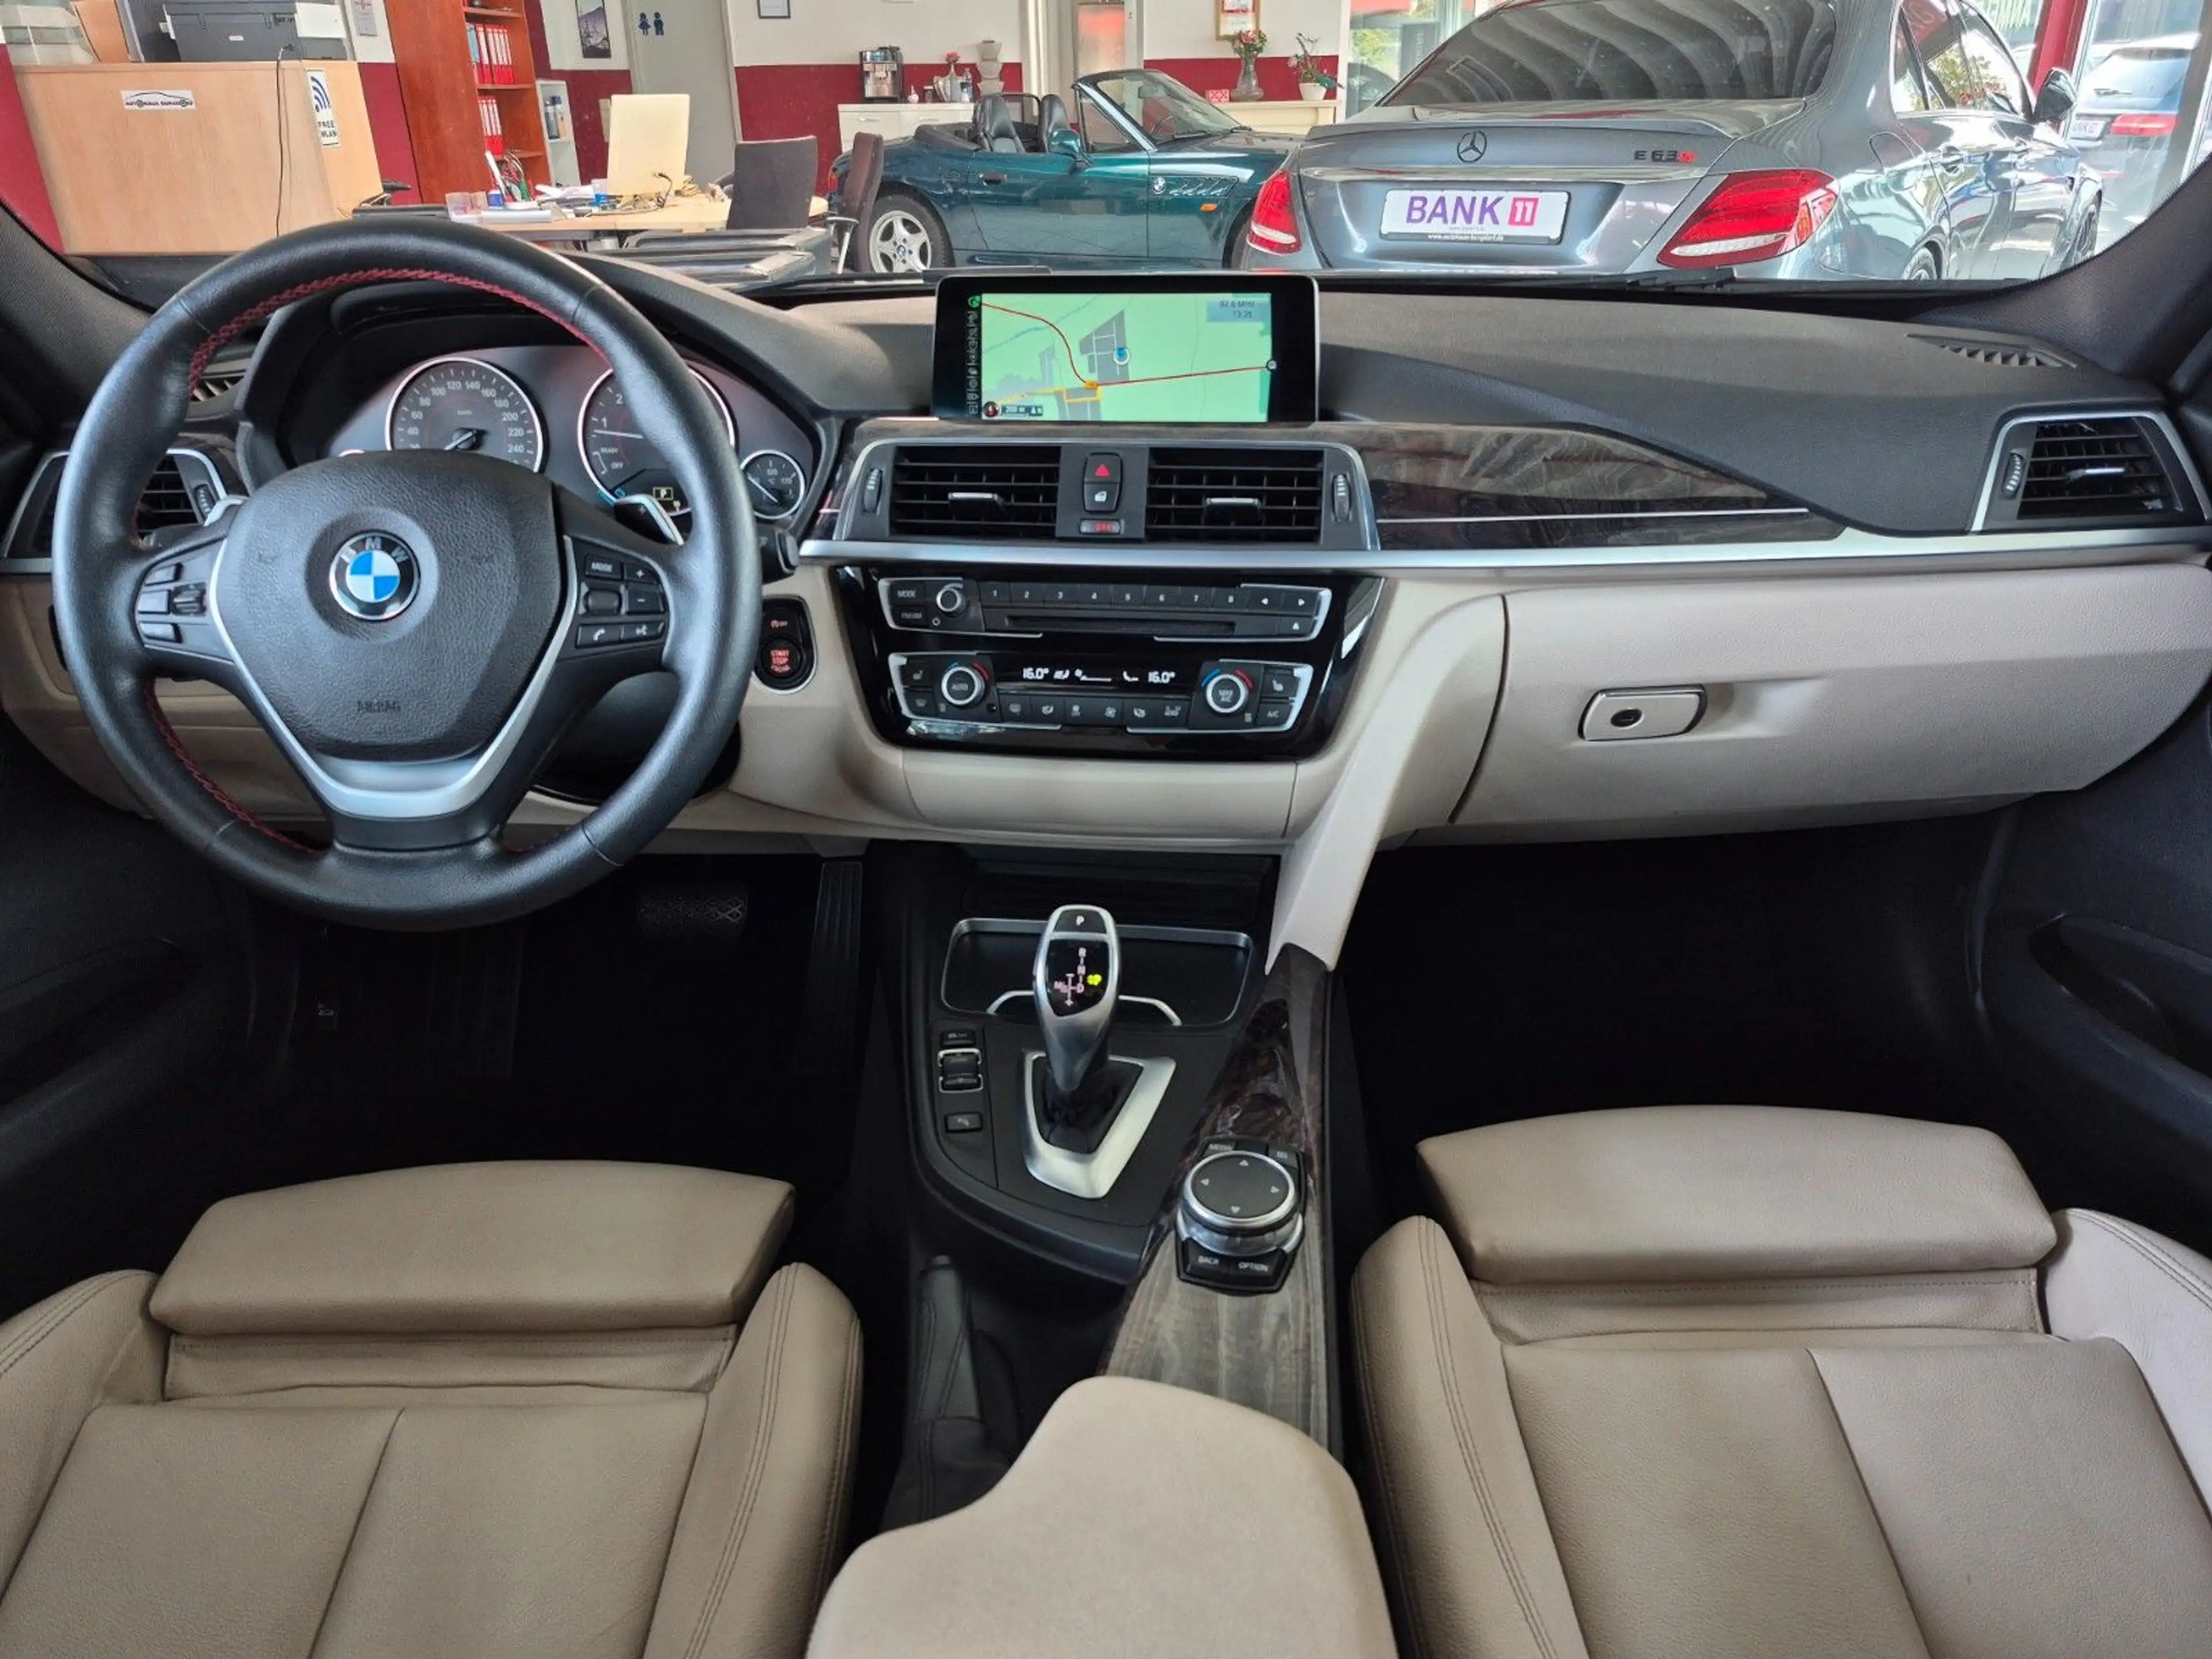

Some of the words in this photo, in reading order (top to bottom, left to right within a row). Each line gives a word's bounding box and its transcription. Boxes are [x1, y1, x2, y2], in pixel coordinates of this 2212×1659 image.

[1634, 150, 1647, 160] E
[1406, 196, 1505, 225] BANK
[447, 381, 461, 389] 120
[465, 381, 480, 389] 140
[431, 388, 446, 396] 100
[481, 388, 497, 397] 160
[419, 397, 431, 407] 80
[494, 399, 509, 408] 180
[616, 394, 623, 404] 2
[411, 411, 423, 419] 60
[502, 411, 518, 421] 200
[601, 418, 607, 428] 1
[408, 427, 419, 435] 40
[507, 428, 524, 437] 220
[507, 444, 525, 453] 240
[339, 536, 409, 564] BMW
[897, 589, 916, 598] MODE
[1076, 915, 1085, 926] P
[1076, 983, 1085, 994] D
[1198, 1255, 1219, 1266] BACK
[1238, 1262, 1268, 1272] OPTION
